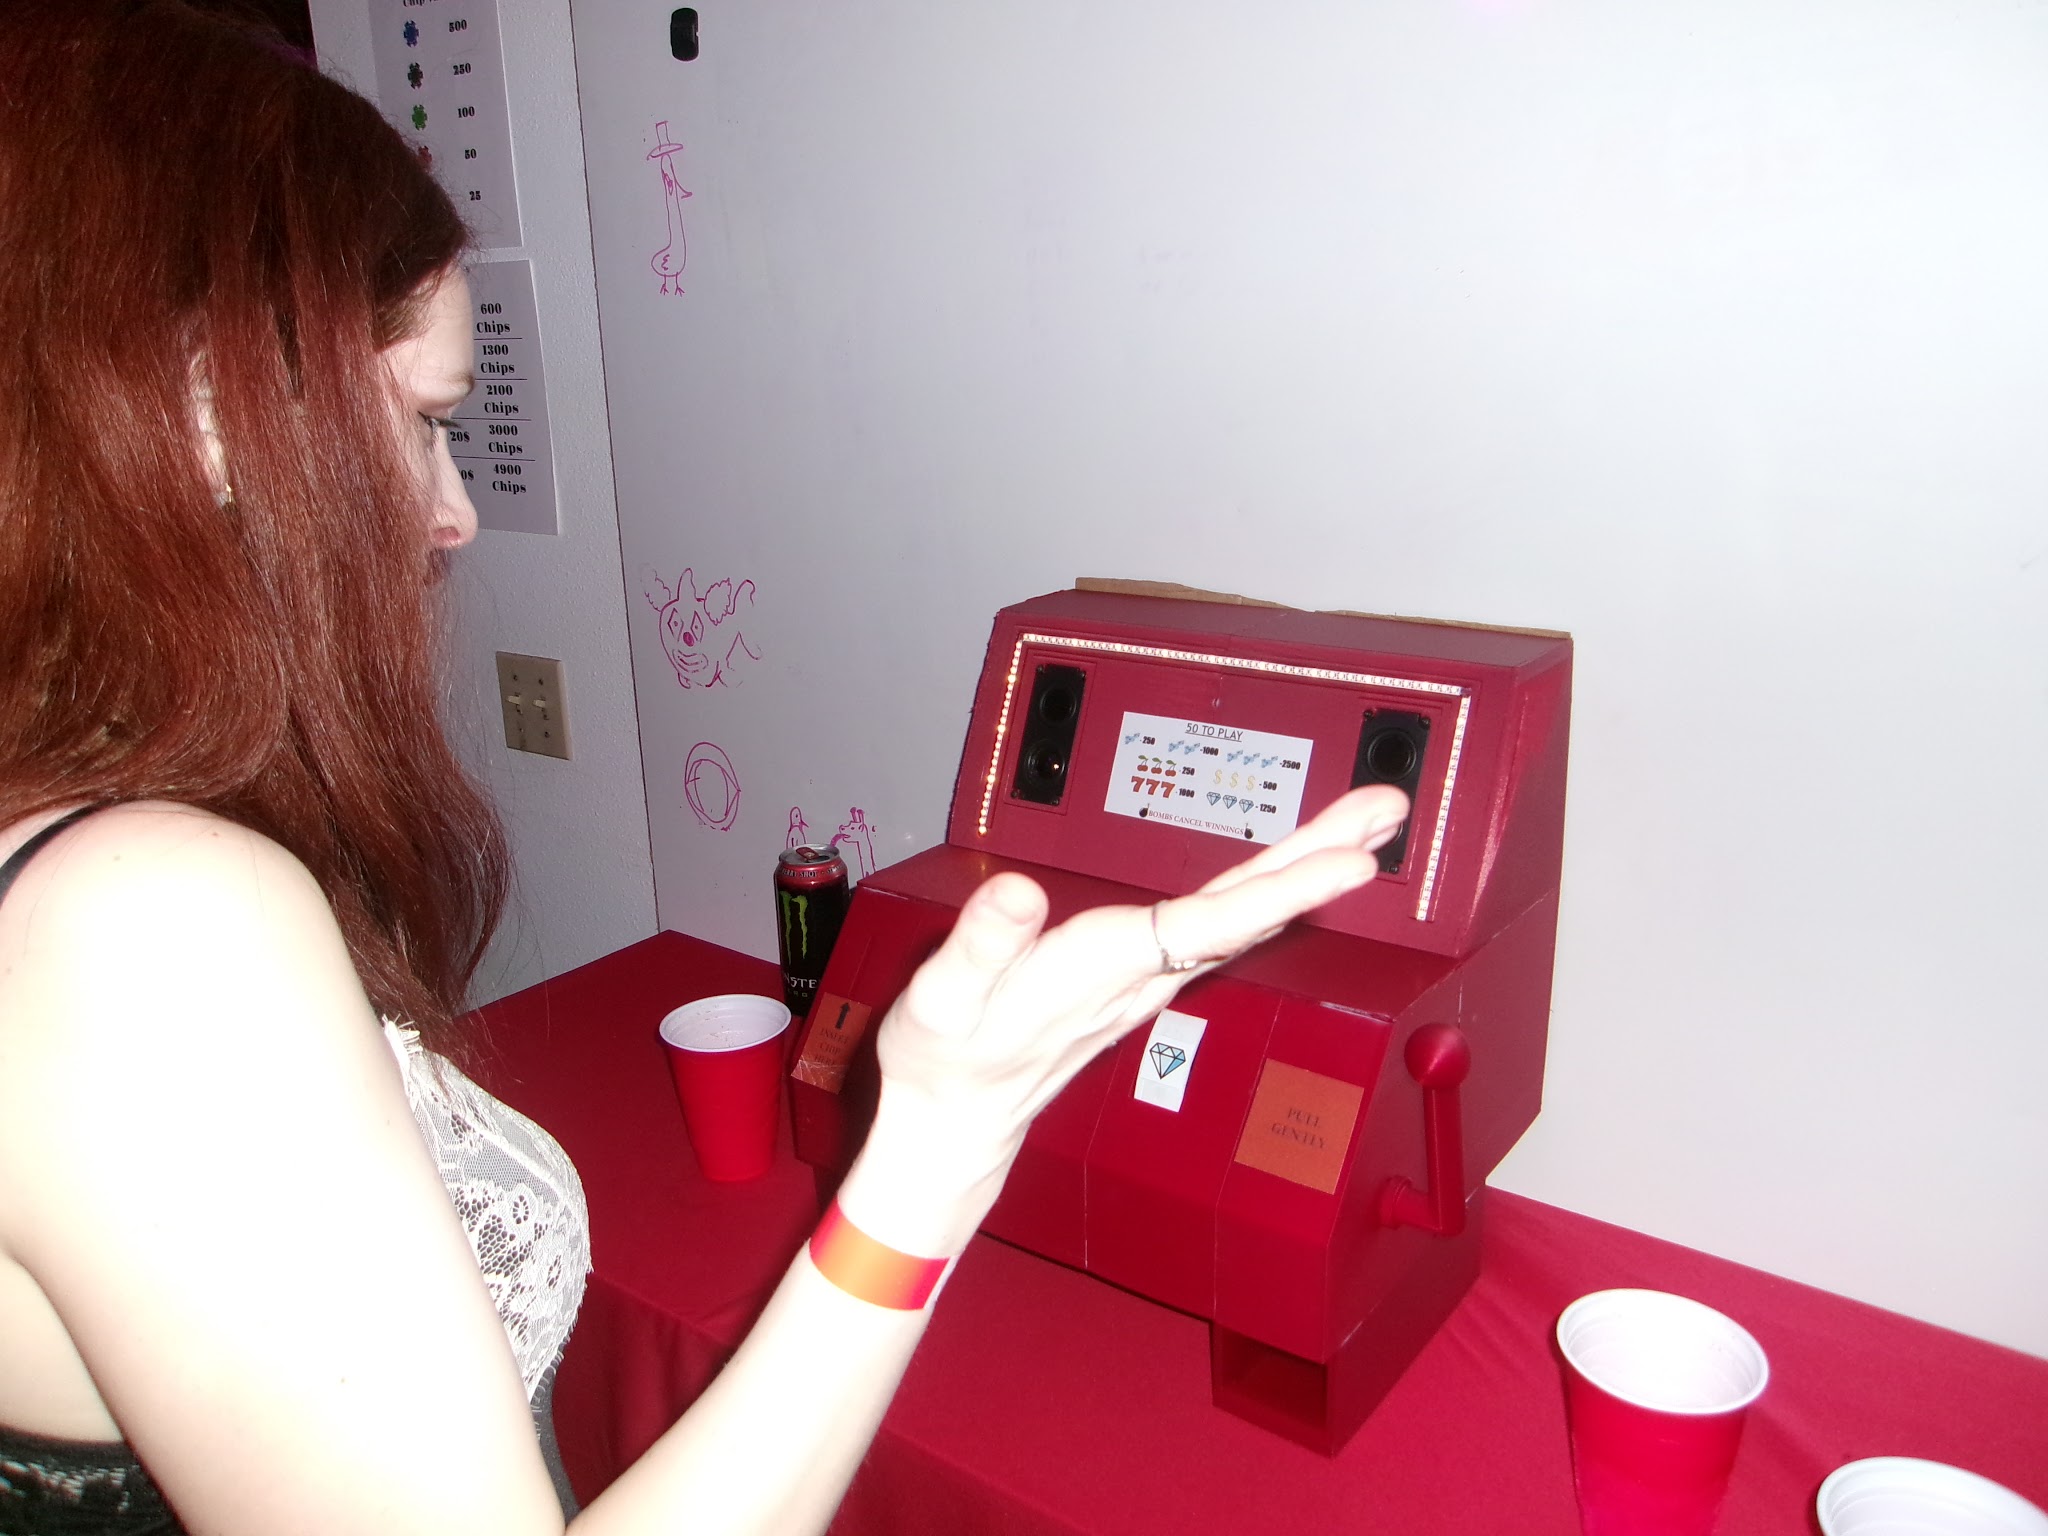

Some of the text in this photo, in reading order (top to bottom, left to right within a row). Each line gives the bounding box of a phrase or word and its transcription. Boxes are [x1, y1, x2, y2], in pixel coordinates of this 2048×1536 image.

[449, 19, 467, 33] 500
[453, 63, 471, 75] 250
[457, 106, 475, 118] 100
[464, 149, 477, 160] 50
[469, 190, 481, 201] 25
[480, 303, 502, 315] 600
[476, 320, 511, 335] Chips
[482, 344, 509, 356] 1300
[480, 361, 515, 376] Chips
[486, 384, 513, 396] 2100
[484, 401, 519, 416] Chips
[450, 424, 518, 443] 20$ 3000
[488, 441, 523, 455] Chips
[459, 463, 522, 481] 0$ 4900
[492, 480, 527, 495] Chips
[1186, 722, 1243, 741] 50 TO PLAY
[1142, 736, 1156, 745] 250
[1182, 766, 1195, 776] 250
[1262, 781, 1277, 791] 500
[1178, 788, 1195, 798] 1000
[1260, 804, 1277, 814] 1250
[1148, 810, 1244, 835] BOMBS CANCEL WINNINGS
[1287, 1107, 1321, 1128] PULL
[1271, 1122, 1325, 1149] GENTLY
